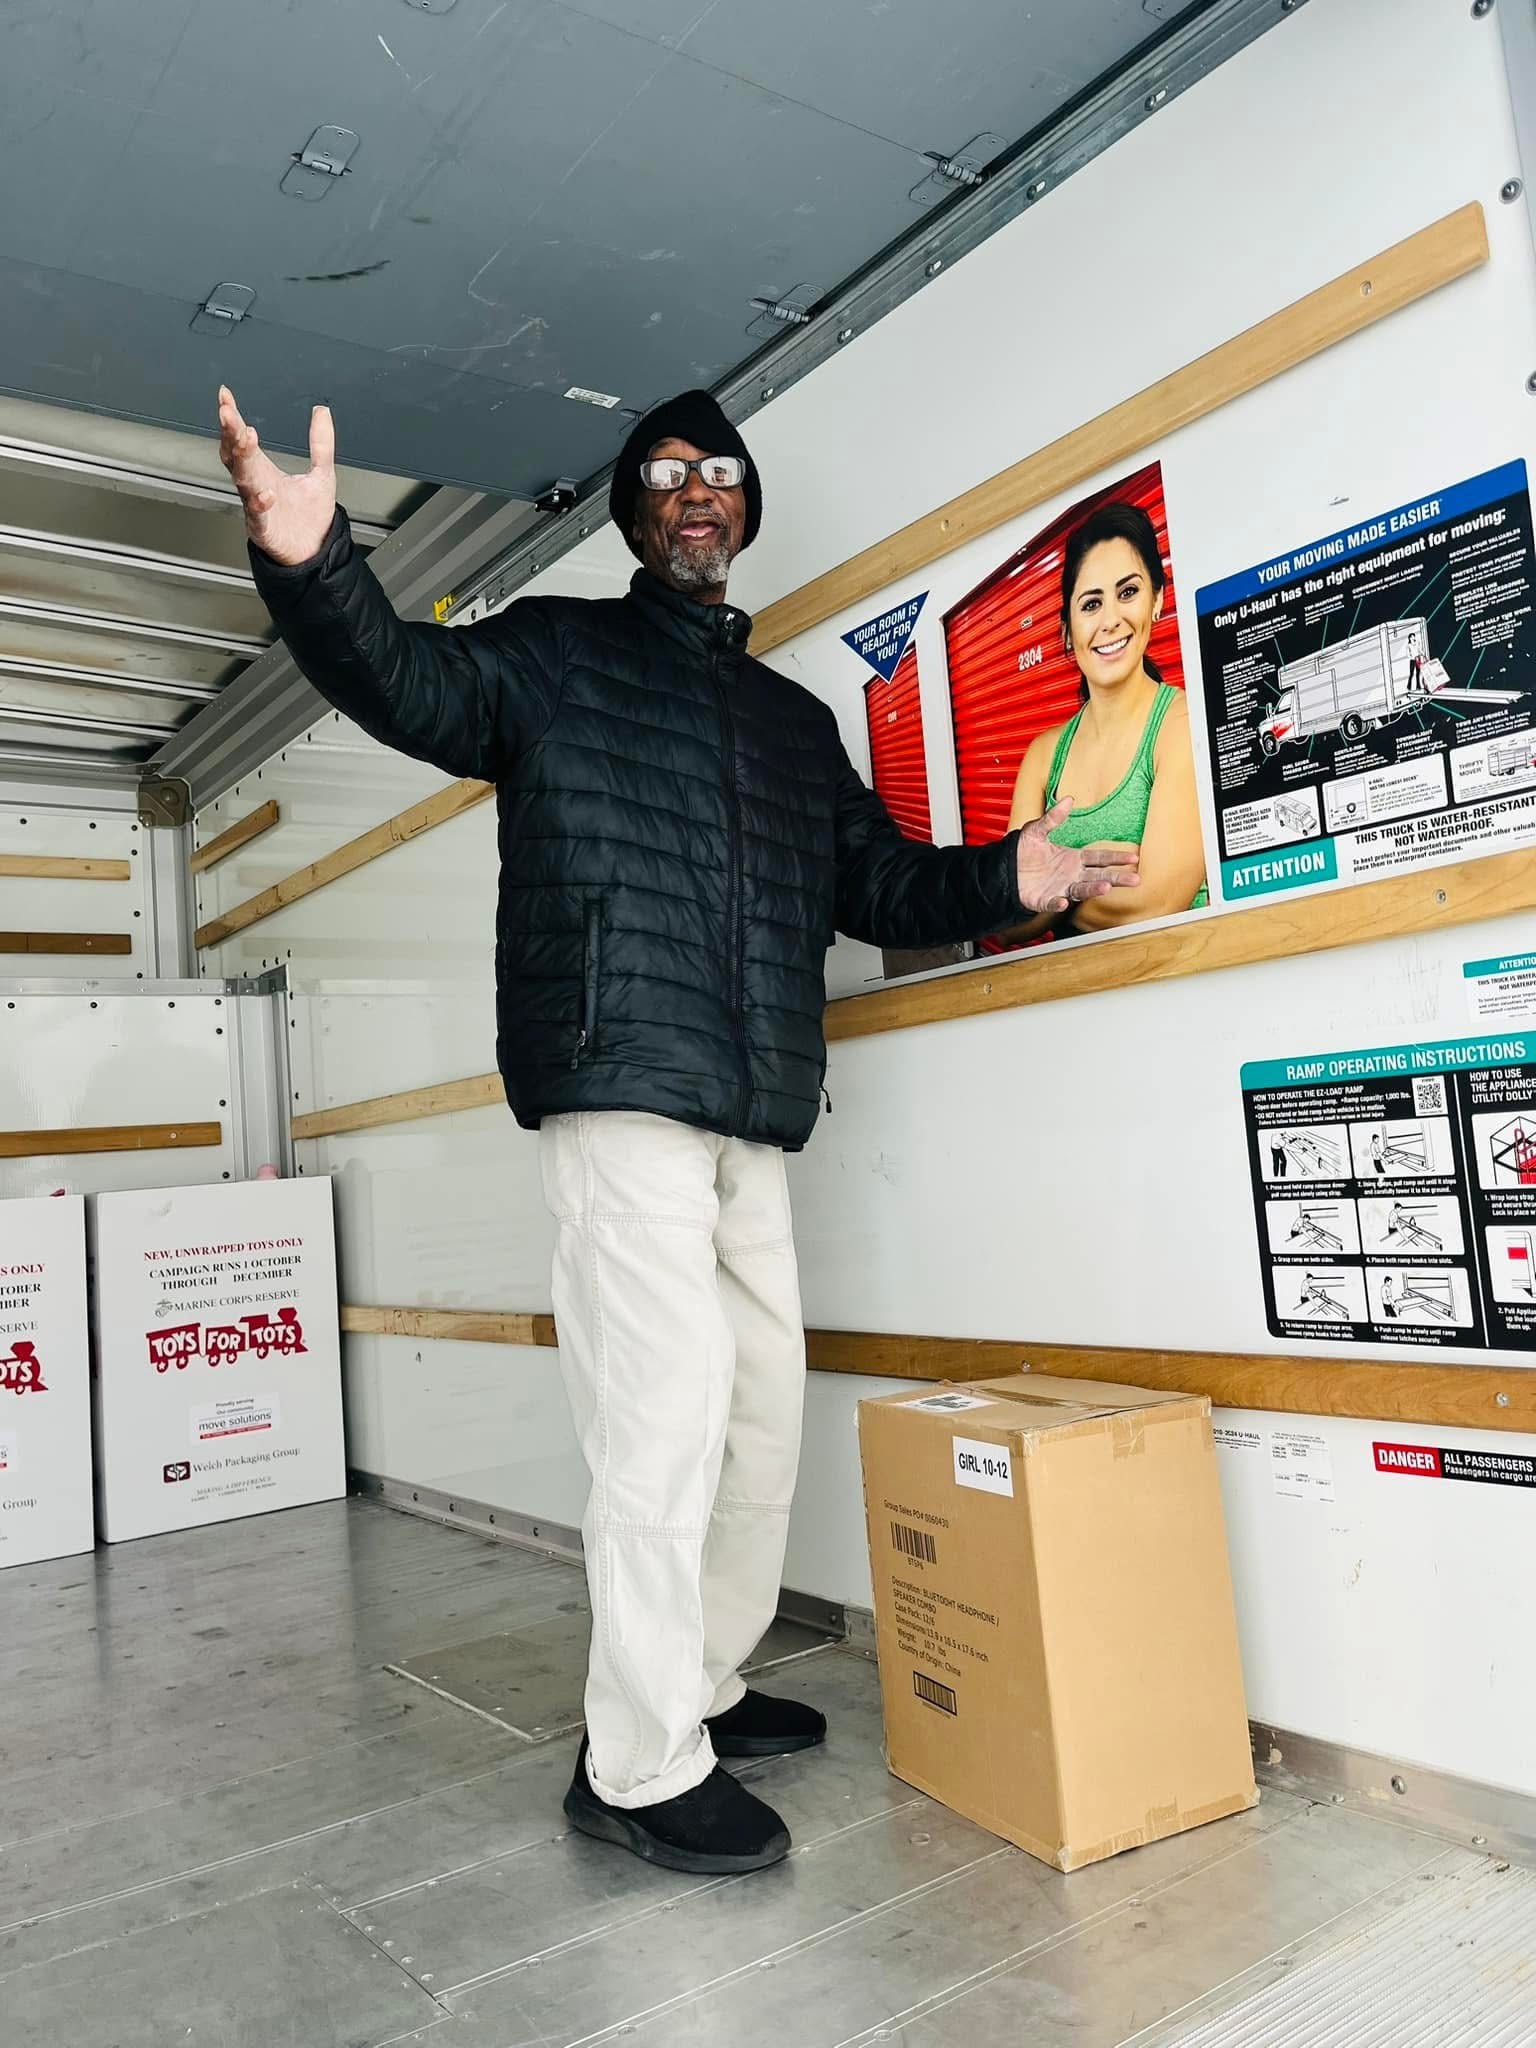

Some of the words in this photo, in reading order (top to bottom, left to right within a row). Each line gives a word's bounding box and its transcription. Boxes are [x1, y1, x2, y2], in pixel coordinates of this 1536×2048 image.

[1257, 560, 1291, 585] YOUR
[1293, 538, 1344, 571] MOVING
[1347, 521, 1387, 550] MADE
[1390, 500, 1441, 533] EASIER
[1214, 609, 1238, 628] Only
[1281, 587, 1303, 603] has
[1304, 578, 1323, 594] the
[1326, 564, 1356, 586] right
[1358, 538, 1426, 576] equipment
[1427, 530, 1448, 548] for
[1451, 508, 1507, 539] moving:
[853, 625, 876, 645] YOUR
[878, 611, 906, 634] ROOM
[909, 602, 918, 617] IS
[861, 634, 891, 655] READY
[893, 620, 911, 641] FOR
[877, 643, 899, 662] YOU!
[1018, 645, 1043, 671] 2304
[1354, 830, 1378, 845] THIS
[1380, 819, 1414, 838] TRUCK
[1417, 819, 1428, 830] IS
[1375, 850, 1397, 862] protect
[1397, 848, 1411, 858] your
[1411, 840, 1442, 853] important
[1443, 834, 1478, 847] documents
[1480, 830, 1493, 840] and
[1494, 827, 1512, 837] other
[1394, 833, 1417, 848] NOT
[1418, 816, 1495, 844] WATERPROOF.
[1232, 851, 1326, 888] ATTENTION
[1394, 852, 1428, 864] waterproof
[1286, 1062, 1325, 1080] RAMP
[1329, 1052, 1407, 1077] OPERATING
[1411, 1041, 1526, 1069] INSTRUCTIONS
[1470, 1070, 1489, 1082] HOW
[1491, 1069, 1503, 1080] TO
[1504, 1067, 1522, 1079] USE
[1470, 1083, 1488, 1093] THE
[1489, 1078, 1536, 1092] APPLIANCE
[1253, 1093, 1267, 1103] HOW
[1268, 1093, 1276, 1101] TO
[1276, 1090, 1303, 1101] OPERATE
[1304, 1089, 1316, 1098] THE
[1345, 1085, 1364, 1094] RAMP
[1472, 1090, 1504, 1104] UTILITY
[144, 1251, 173, 1261] NEW,
[175, 1243, 244, 1258] UNWRAPPED
[246, 1240, 275, 1250] TOYS
[276, 1237, 304, 1249] ONLY
[11, 1263, 46, 1275] ONLY
[149, 1264, 210, 1279] CAMPAIGN
[212, 1261, 241, 1272] RUNS
[250, 1255, 302, 1268] OCTOBER
[161, 1276, 217, 1290] THROUGH
[233, 1268, 292, 1282] DECEMBER
[174, 1299, 217, 1312] MARINE
[219, 1294, 253, 1306] CORPS
[255, 1288, 300, 1301] RESERVE
[151, 1331, 197, 1357] TOYS
[207, 1331, 241, 1351] FOR
[251, 1324, 296, 1345] TOTS
[199, 1421, 226, 1432] move
[229, 1410, 272, 1427] solutions
[192, 1460, 223, 1473] Welch
[225, 1452, 271, 1468] Packaging
[272, 1447, 300, 1460] Group
[958, 1451, 981, 1474] GIRL
[982, 1457, 1008, 1479] 10-12
[1377, 1448, 1436, 1470] DANGER
[1444, 1452, 1463, 1465] ALL
[1464, 1454, 1534, 1473] PASSENGERS
[1445, 1464, 1490, 1478] Passengers
[1491, 1469, 1499, 1479] in
[1500, 1470, 1524, 1482] cargo
[2, 1498, 38, 1511] Group
[891, 1575, 922, 1597] Description:
[956, 1603, 996, 1626] HEADPHONE
[893, 1588, 916, 1605] SPEAKER
[916, 1598, 937, 1615] COMBO
[895, 1601, 908, 1614] Case
[907, 1606, 922, 1620] Pack:
[898, 1639, 920, 1659] Country
[919, 1650, 925, 1659] of
[924, 1653, 945, 1671] Origin:
[944, 1660, 962, 1678] China
